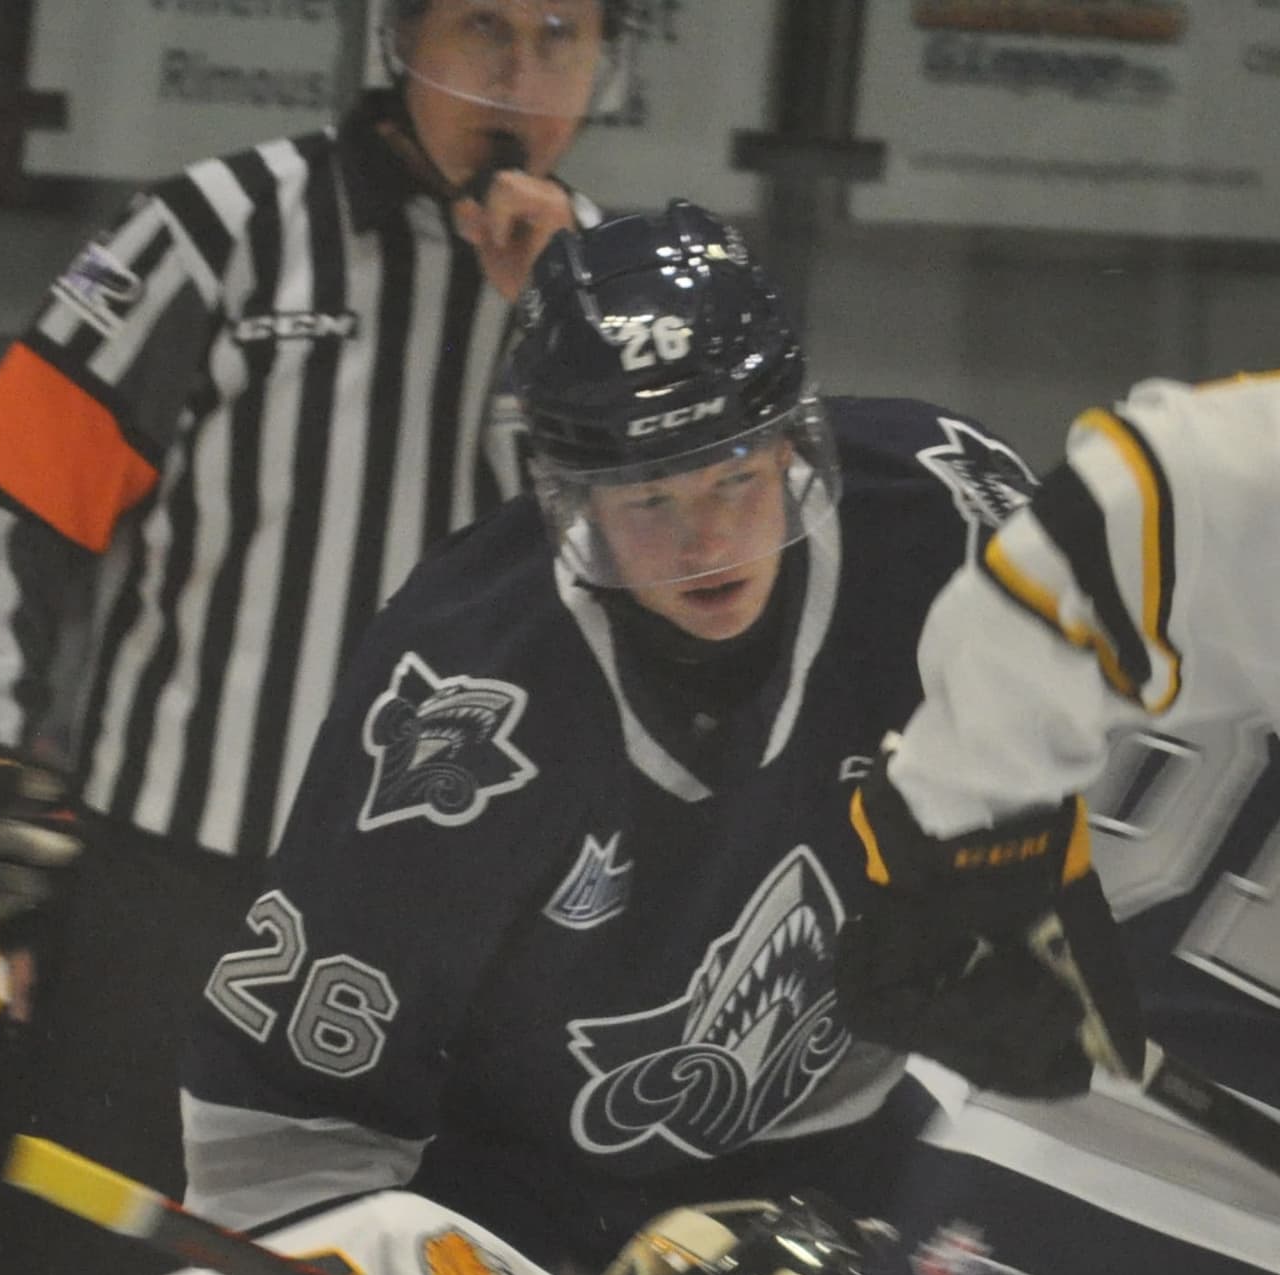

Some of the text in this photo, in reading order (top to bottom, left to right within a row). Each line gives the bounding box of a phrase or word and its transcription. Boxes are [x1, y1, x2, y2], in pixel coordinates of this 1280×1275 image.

[622, 315, 690, 370] 26
[627, 398, 725, 437] CCM
[205, 890, 400, 1077] 26
